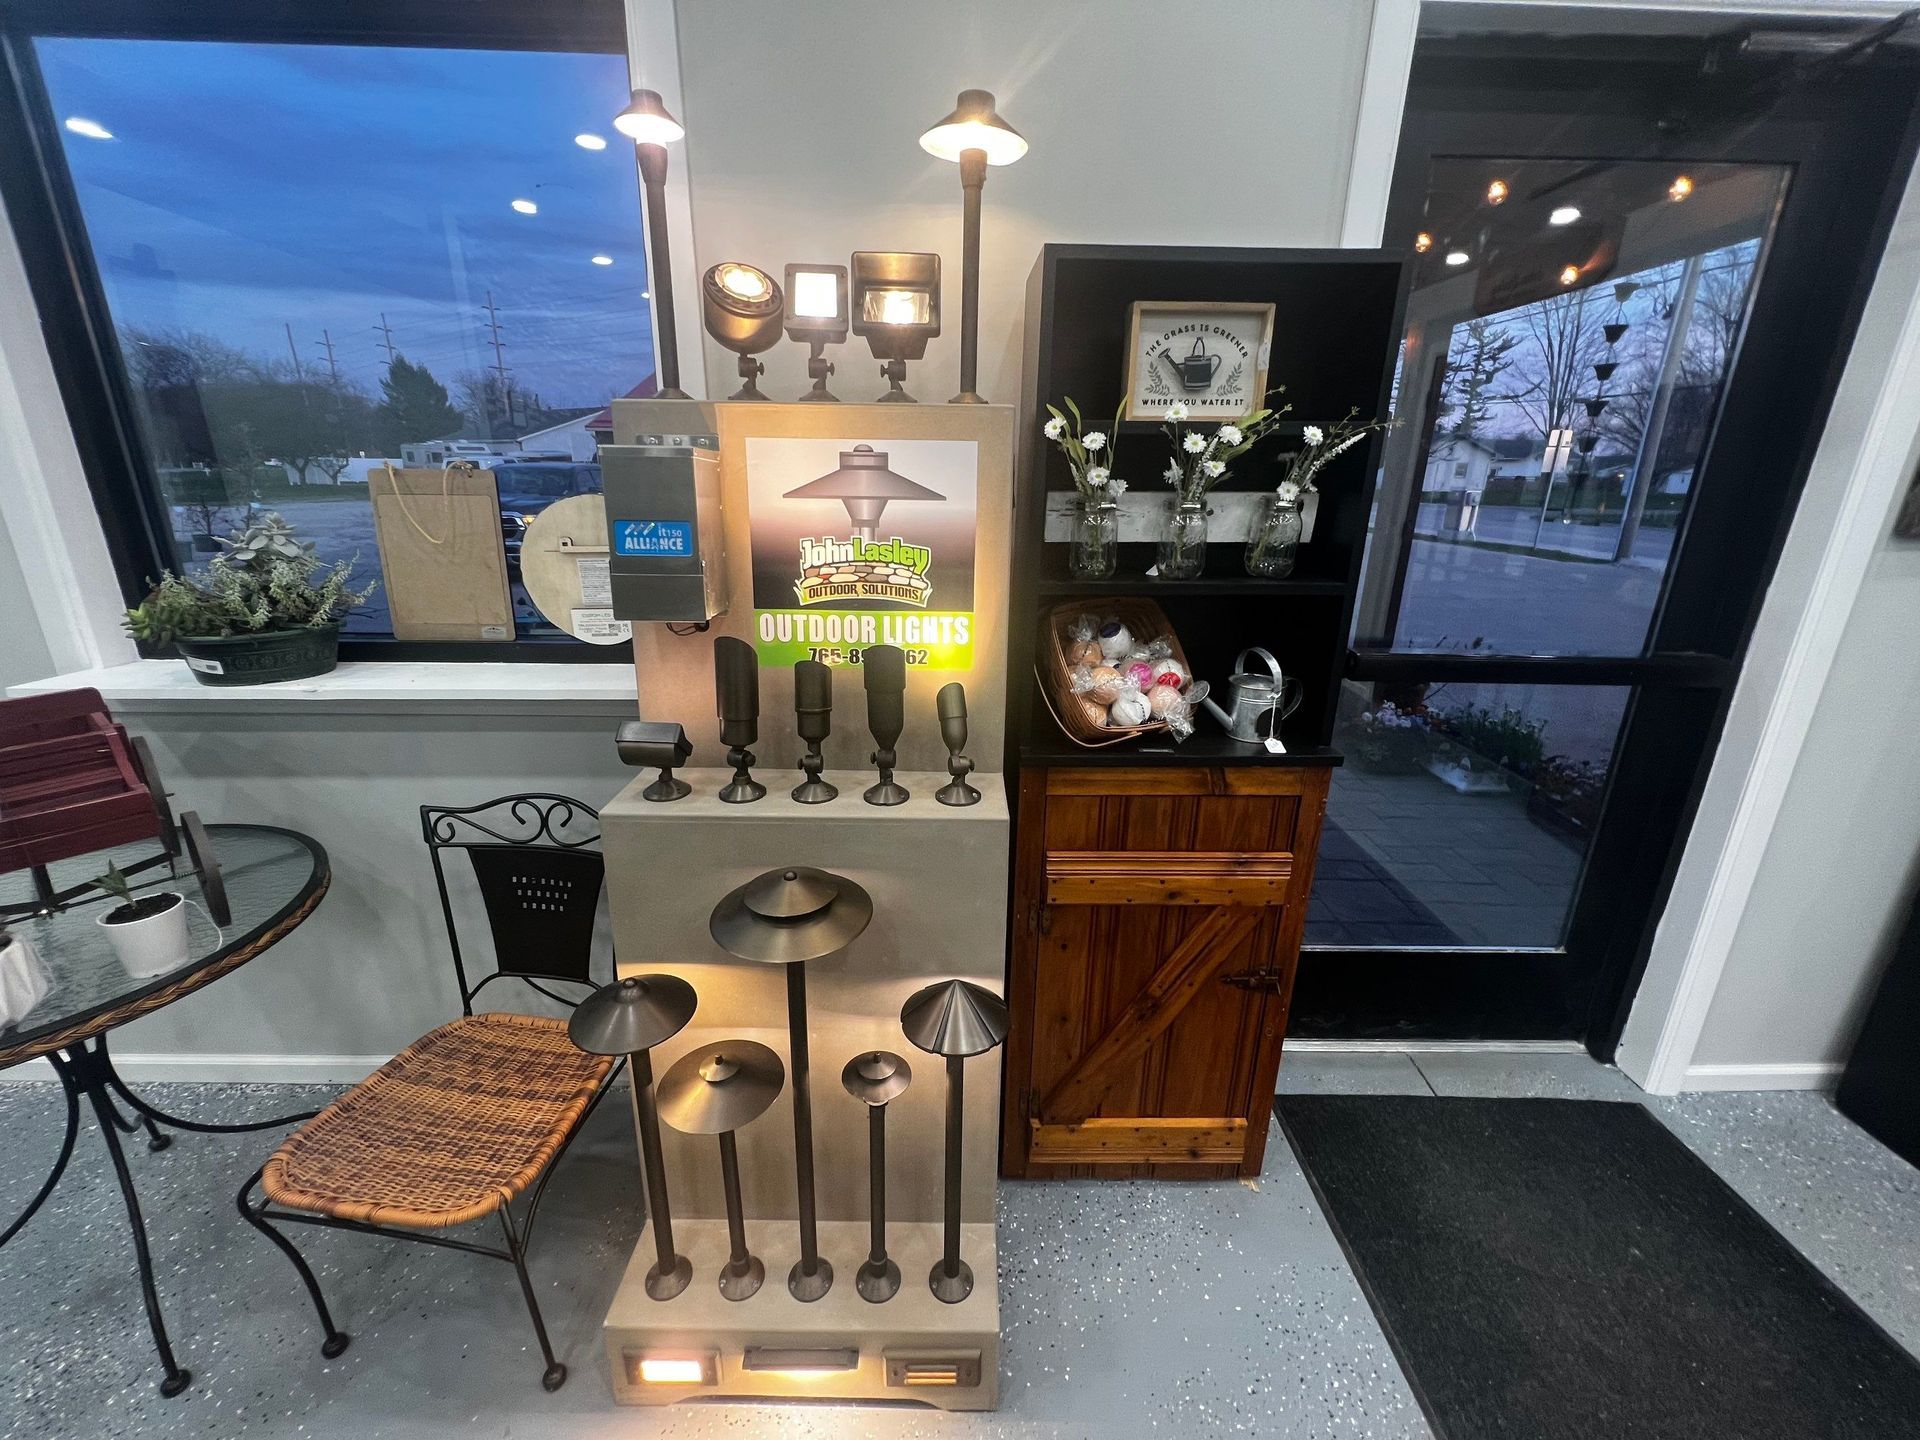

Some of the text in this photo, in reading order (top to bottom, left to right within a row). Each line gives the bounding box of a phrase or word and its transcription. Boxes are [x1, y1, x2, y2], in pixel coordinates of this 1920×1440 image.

[1145, 323, 1249, 359] THE GRASS IS GREENER
[1141, 398, 1174, 406] WHERE
[1201, 398, 1231, 406] WATER
[1234, 398, 1245, 406] IT
[625, 537, 684, 550] ALLIANCE
[808, 583, 919, 600] OUTDOOR SOLUTIONS
[758, 612, 970, 645] OUTDOOR LIGHTS
